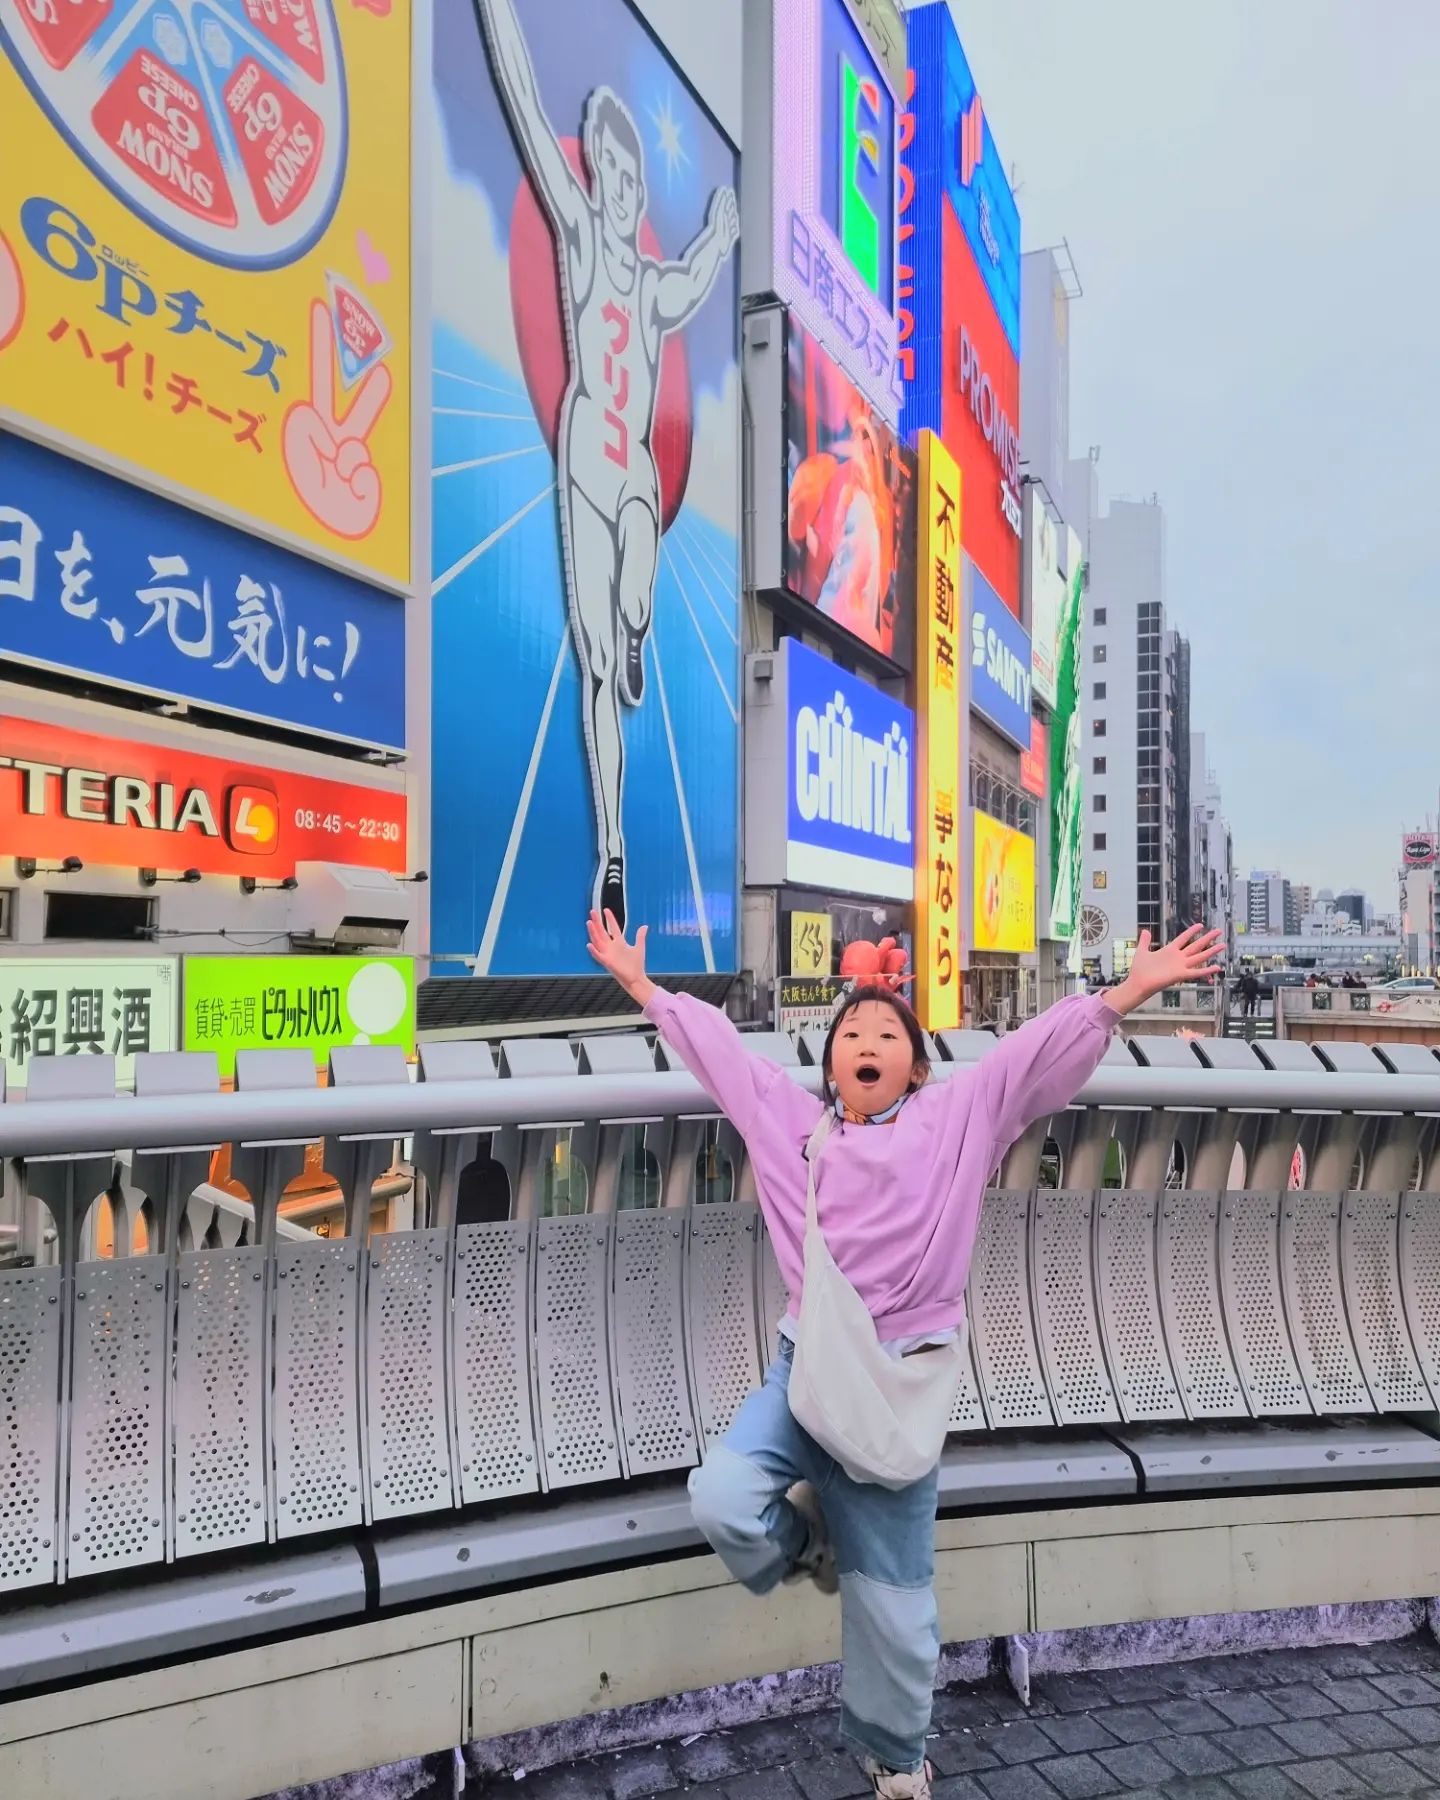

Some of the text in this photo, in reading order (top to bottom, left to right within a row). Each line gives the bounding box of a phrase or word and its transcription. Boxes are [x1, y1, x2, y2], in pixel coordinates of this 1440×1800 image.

[117, 119, 213, 208] SNOW
[263, 121, 313, 210] SNOW
[601, 298, 632, 471] グリコ
[0, 986, 152, 1066] 紹興酒
[261, 985, 343, 1041] ピタットハウス
